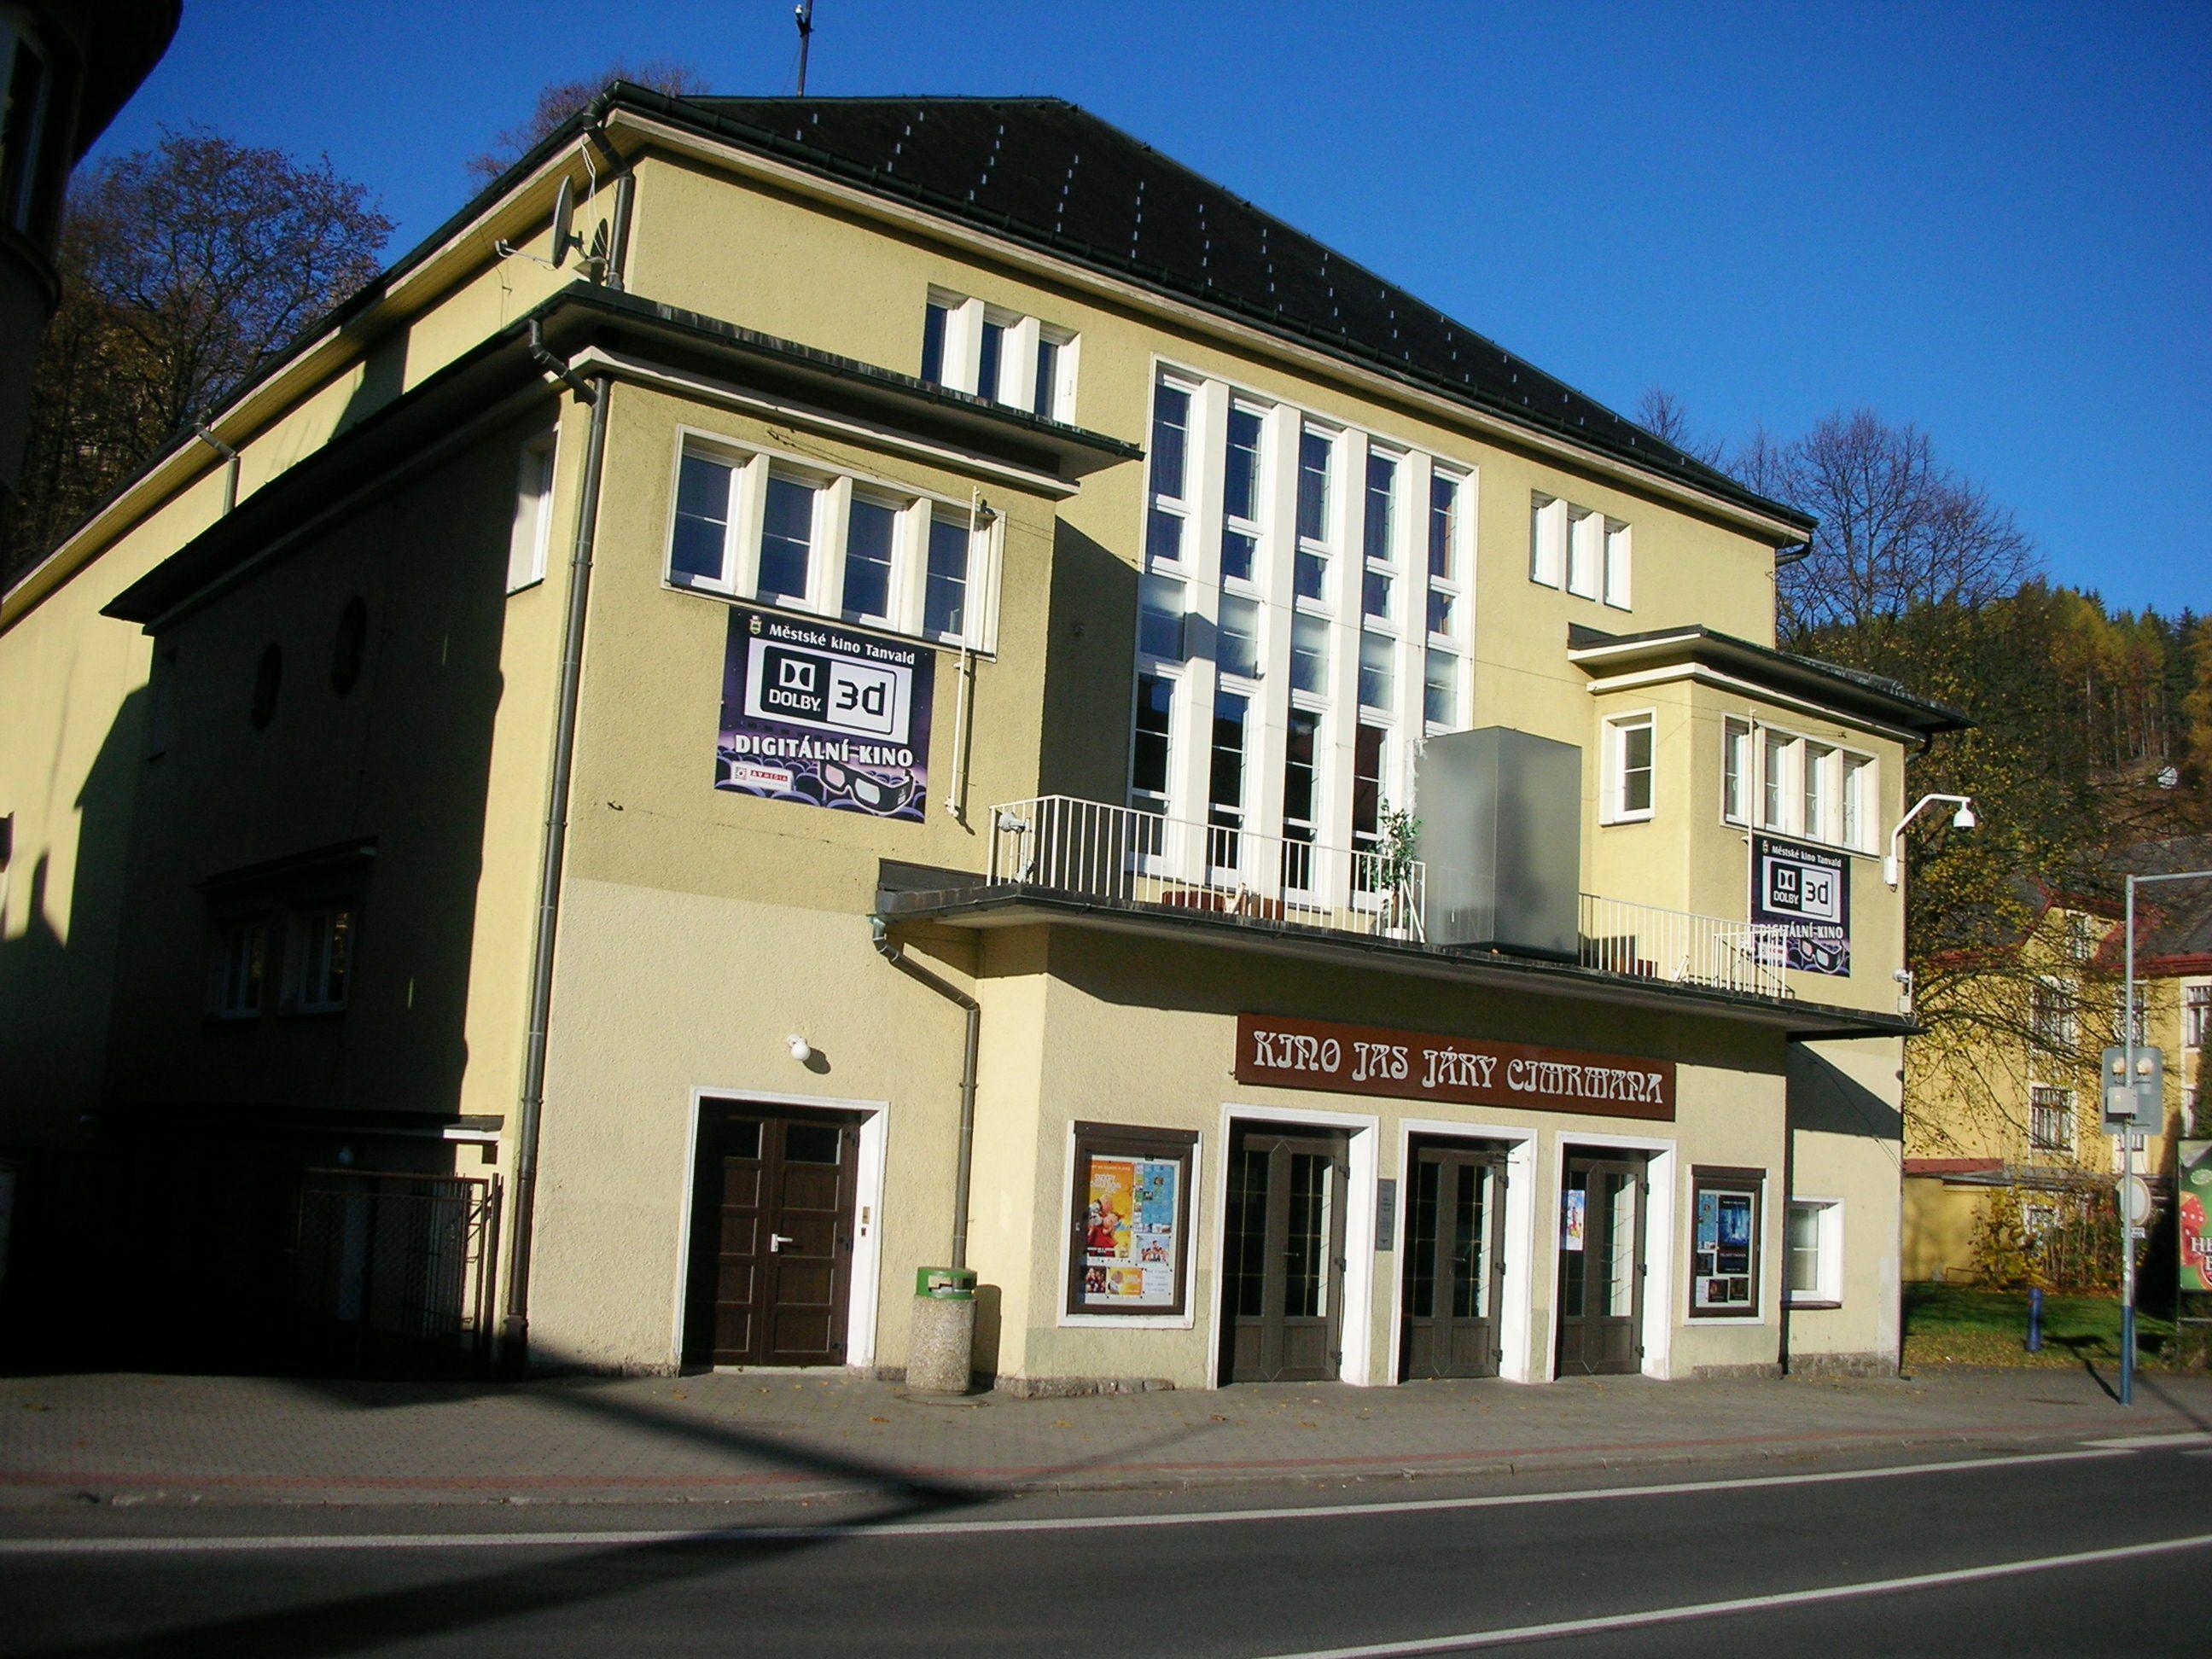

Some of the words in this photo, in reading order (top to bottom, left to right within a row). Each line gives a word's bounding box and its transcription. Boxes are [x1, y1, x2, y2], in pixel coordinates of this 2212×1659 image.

[769, 622, 826, 646] Městské
[830, 636, 860, 654] kino
[865, 643, 915, 665] Tanvald
[769, 689, 821, 711] DOLBY
[835, 679, 886, 716] 3d
[735, 734, 850, 761] DIGITÁLNÍ
[859, 746, 913, 766] KINO
[1773, 890, 1799, 905] DOLBY
[1805, 881, 1828, 905] 3d
[1817, 926, 1843, 940] KINO
[1351, 1041, 1409, 1082] JAS
[1421, 1046, 1498, 1089] JÁRY
